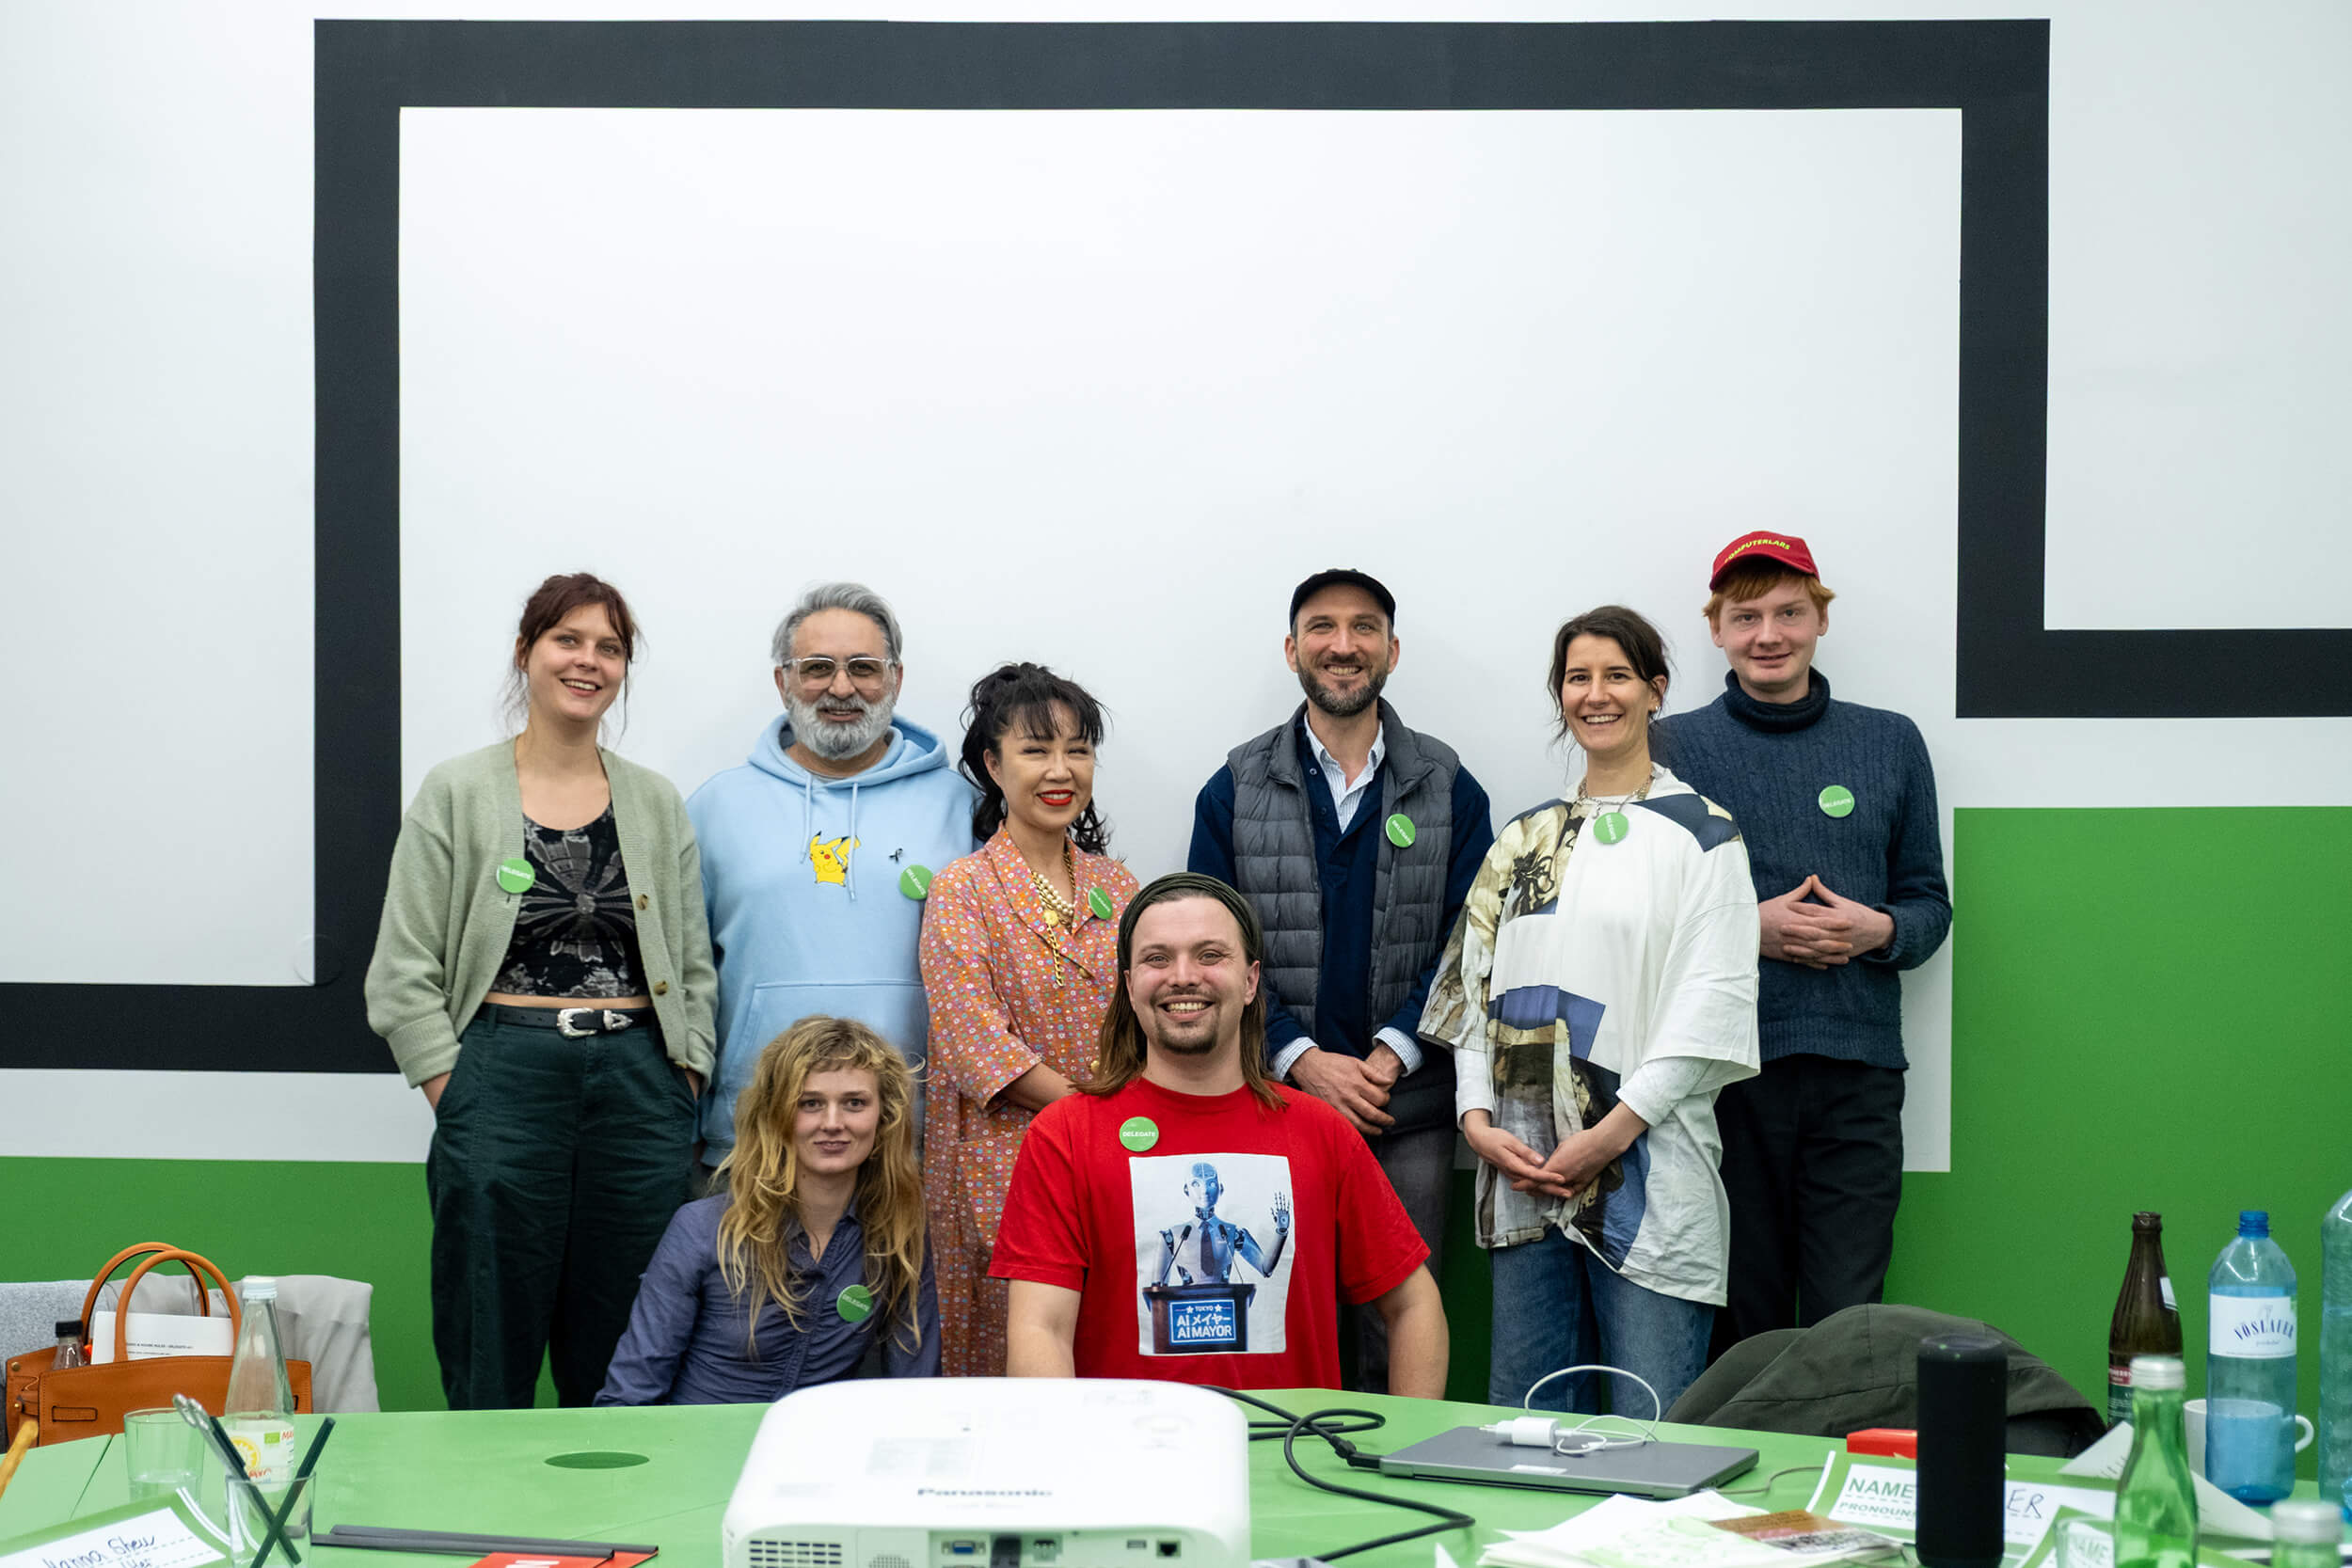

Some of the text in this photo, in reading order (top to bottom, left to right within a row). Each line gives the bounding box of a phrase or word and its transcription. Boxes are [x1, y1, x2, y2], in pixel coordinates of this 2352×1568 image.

[1391, 819, 1413, 846] DELEGATE
[905, 867, 927, 895] DELEGATE
[1122, 1130, 1156, 1138] DELEGATE
[842, 1293, 870, 1313] DELEGATE
[1192, 1313, 1232, 1326] メイヤー
[1177, 1325, 1232, 1339] AI MAYOR
[917, 1487, 1053, 1497] Panasonic
[1849, 1477, 1915, 1499] NAME
[1839, 1501, 1915, 1518] PRONOUN
